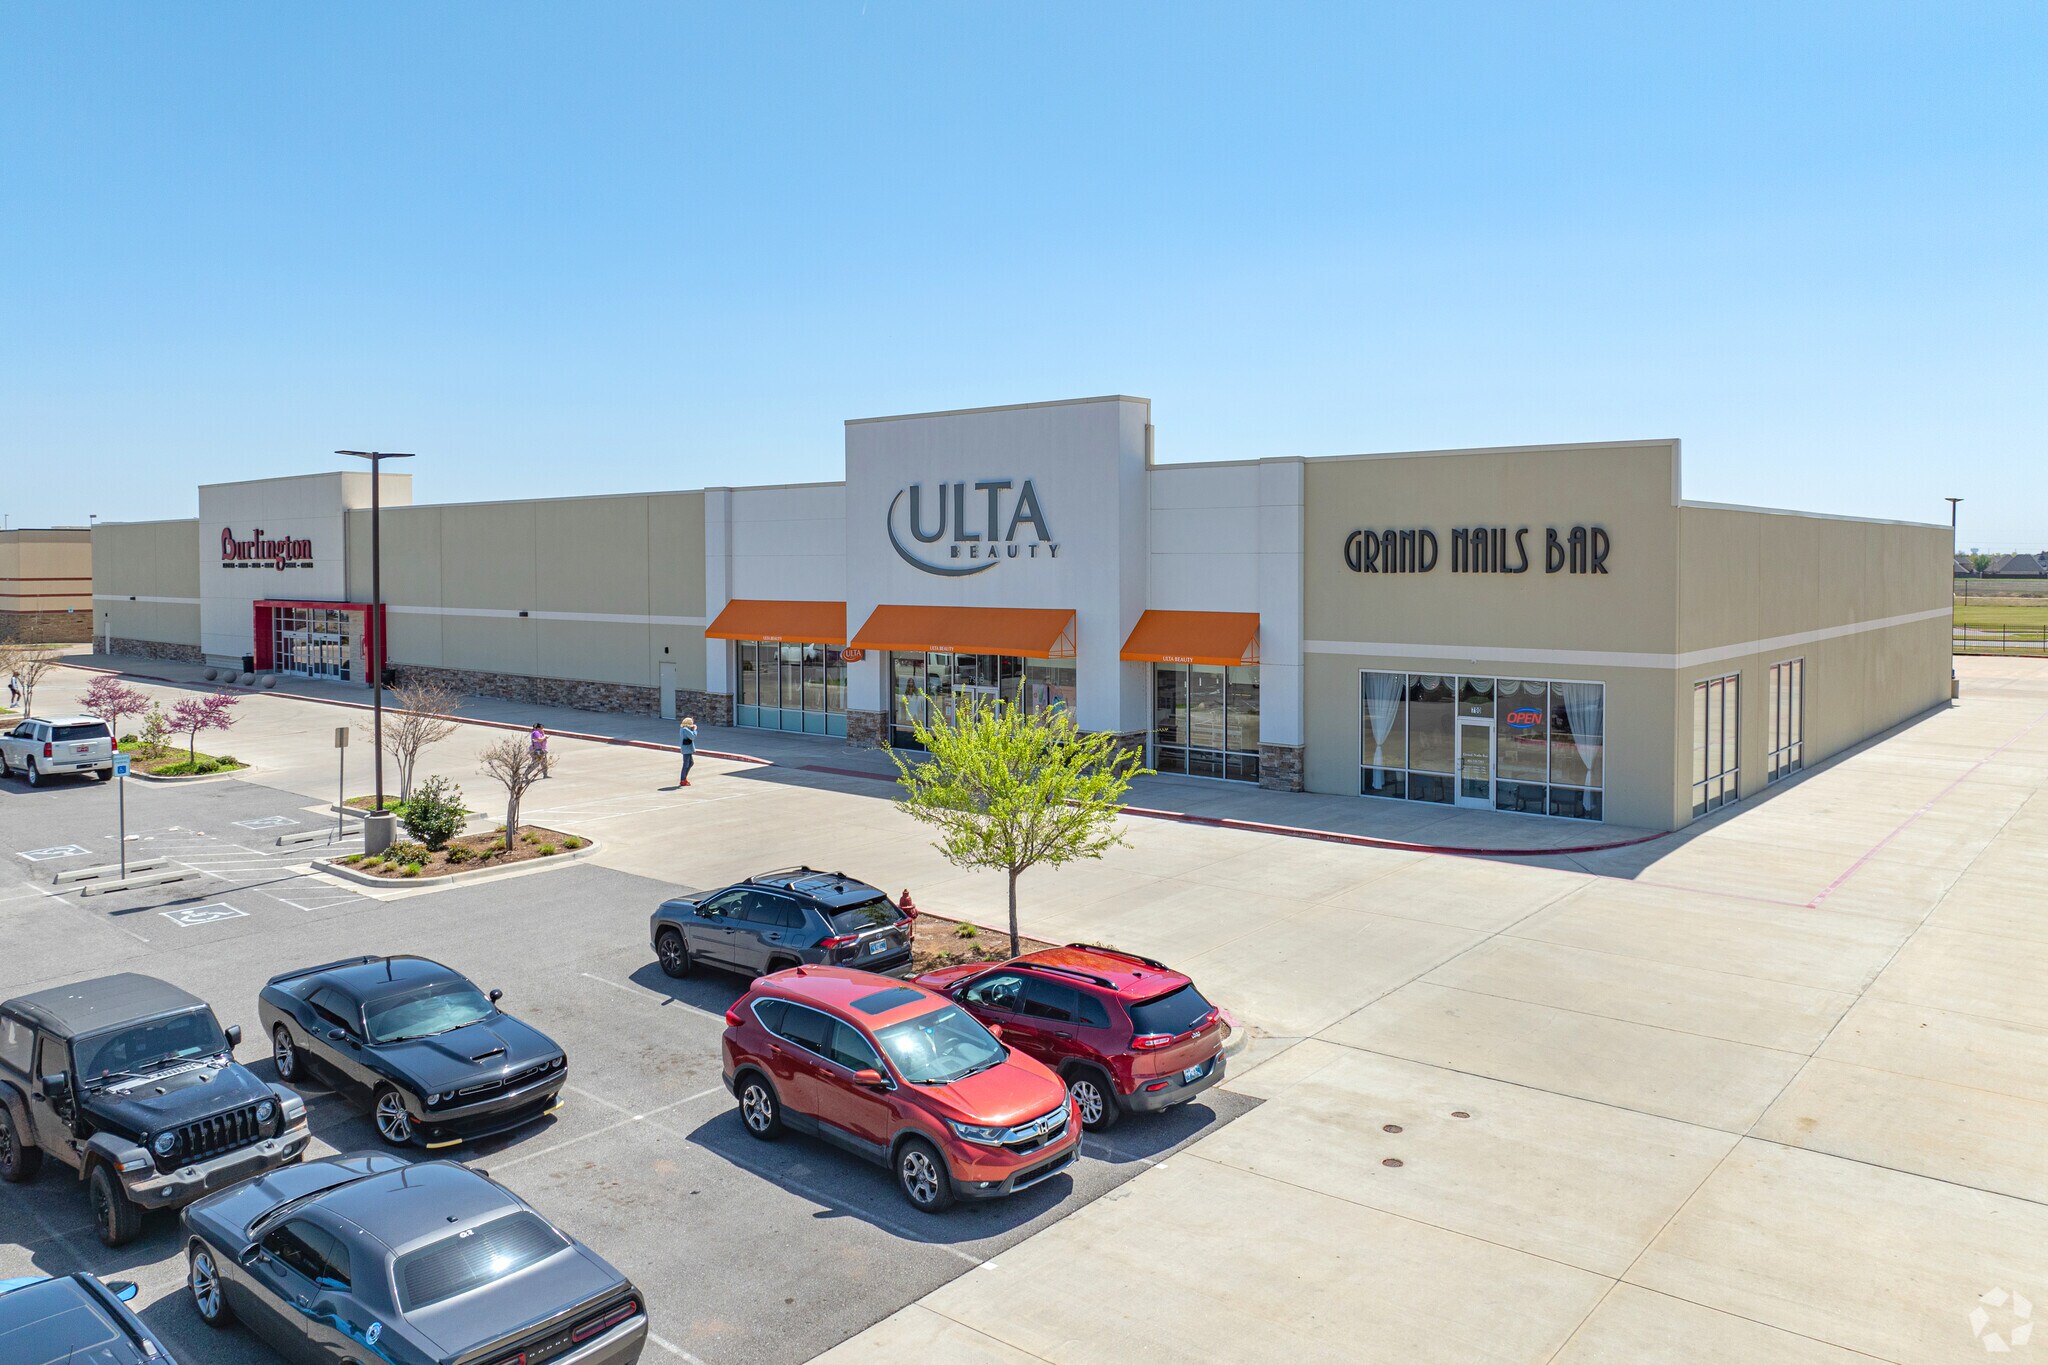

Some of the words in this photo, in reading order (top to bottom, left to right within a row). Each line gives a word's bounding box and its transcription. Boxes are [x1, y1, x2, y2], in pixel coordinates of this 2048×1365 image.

[909, 480, 1052, 544] ULTA
[221, 527, 314, 572] Burlington
[950, 544, 1060, 559] BEAUTY
[1344, 529, 1439, 574] GRAND
[1451, 527, 1529, 574] NAILS
[1545, 526, 1610, 575] BAR
[1506, 712, 1542, 724] OPEN
[529, 1337, 569, 1359] DODGE
